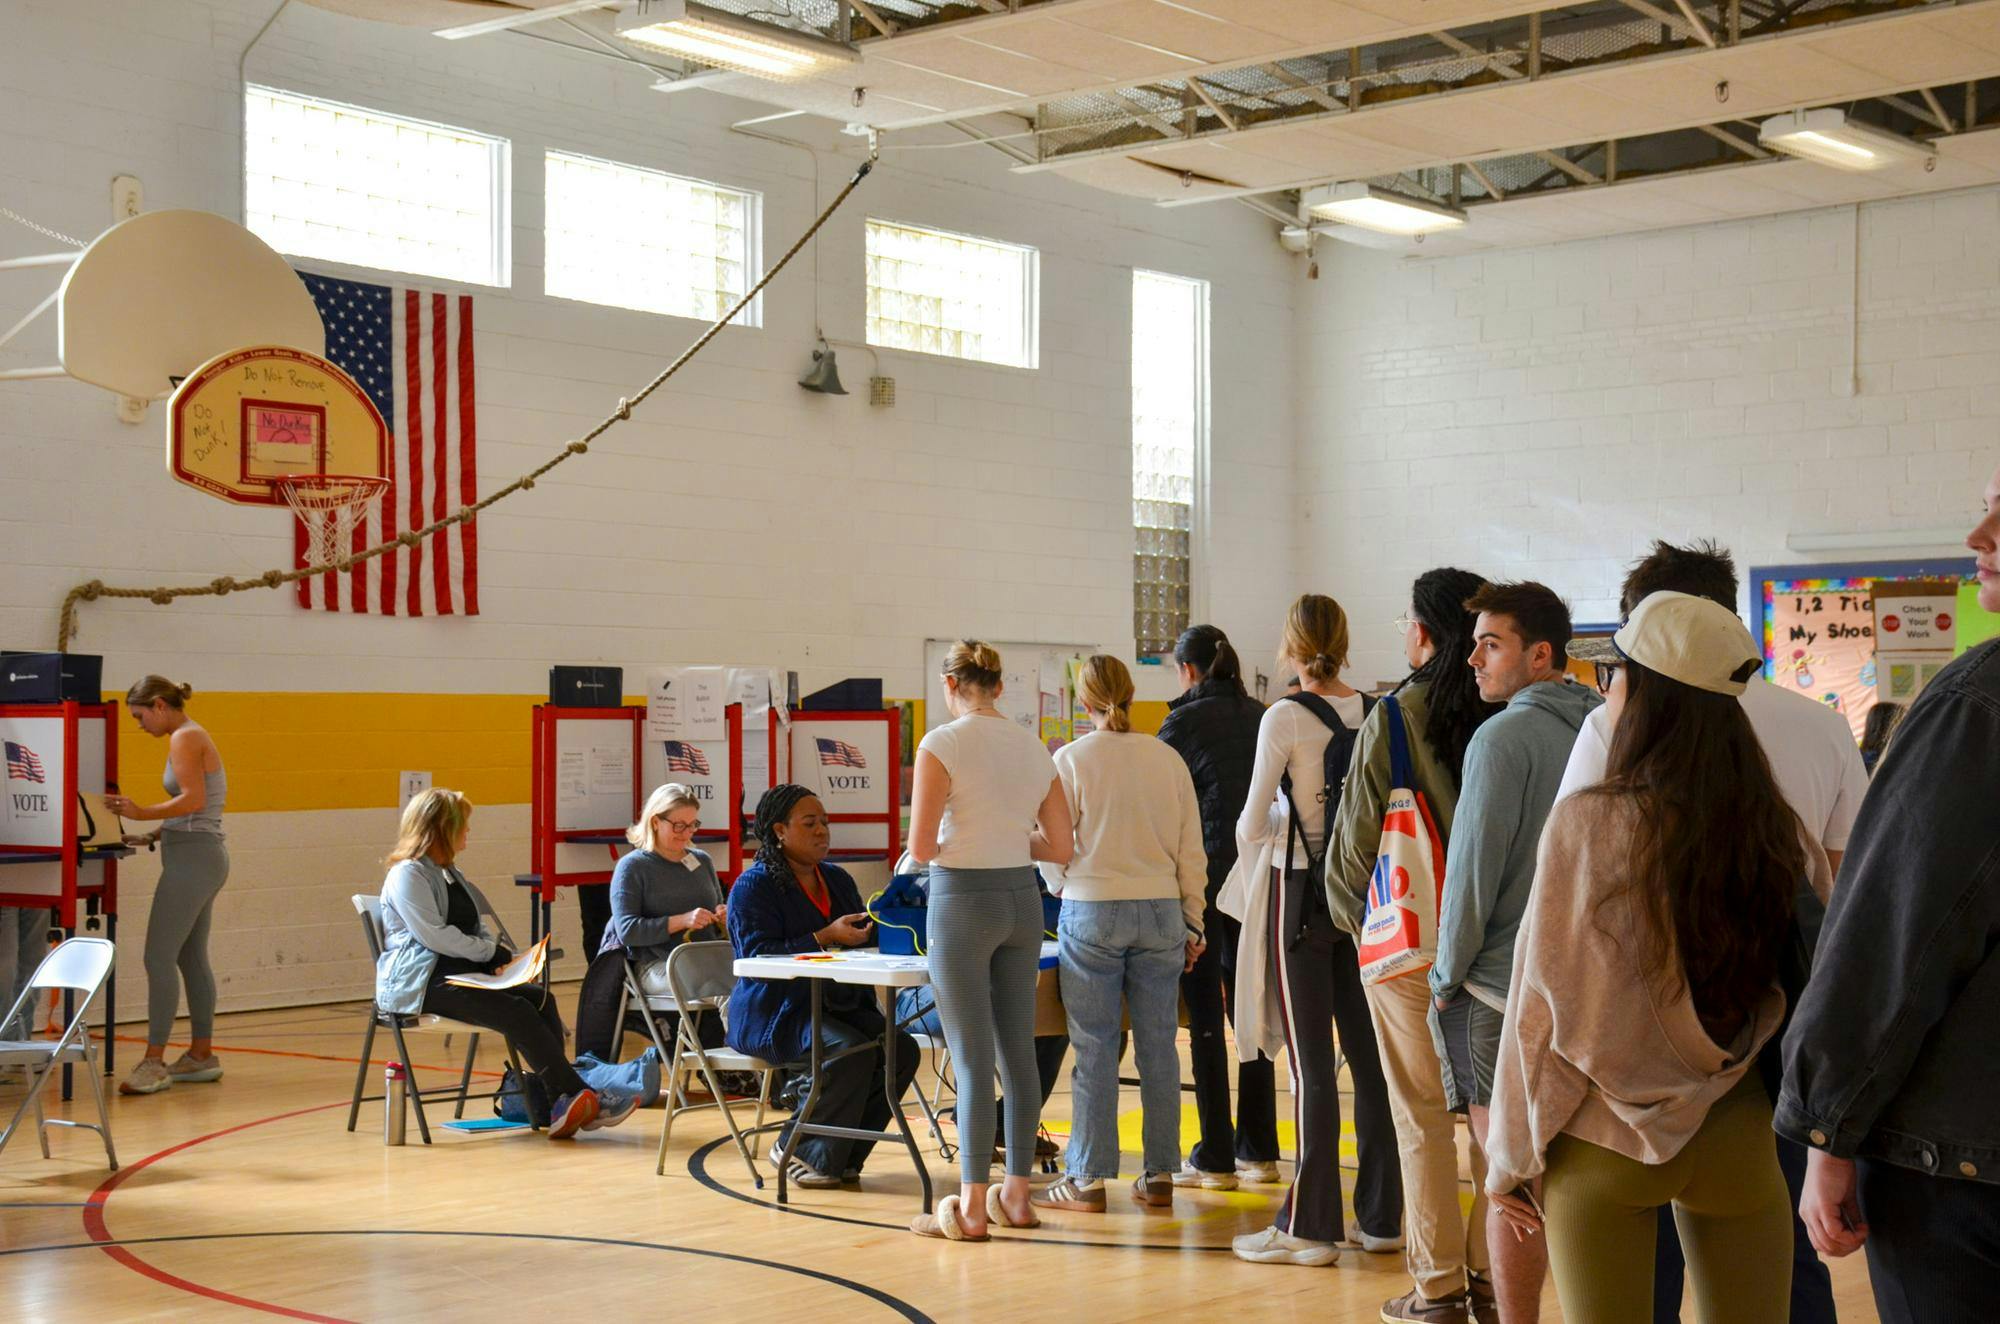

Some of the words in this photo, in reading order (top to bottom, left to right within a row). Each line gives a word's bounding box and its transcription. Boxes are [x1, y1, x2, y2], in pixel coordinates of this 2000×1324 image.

[245, 366, 257, 380] Do
[264, 367, 282, 382] Not
[194, 404, 212, 419] Do
[262, 411, 276, 429] No
[194, 423, 210, 438] Not
[1796, 597, 1823, 615] 1,2
[1903, 605, 1932, 613] Check
[1908, 618, 1928, 626] Your
[1790, 624, 1816, 645] My
[1907, 630, 1930, 638] Work
[827, 776, 870, 789] VOTE
[13, 794, 48, 811] VOTE
